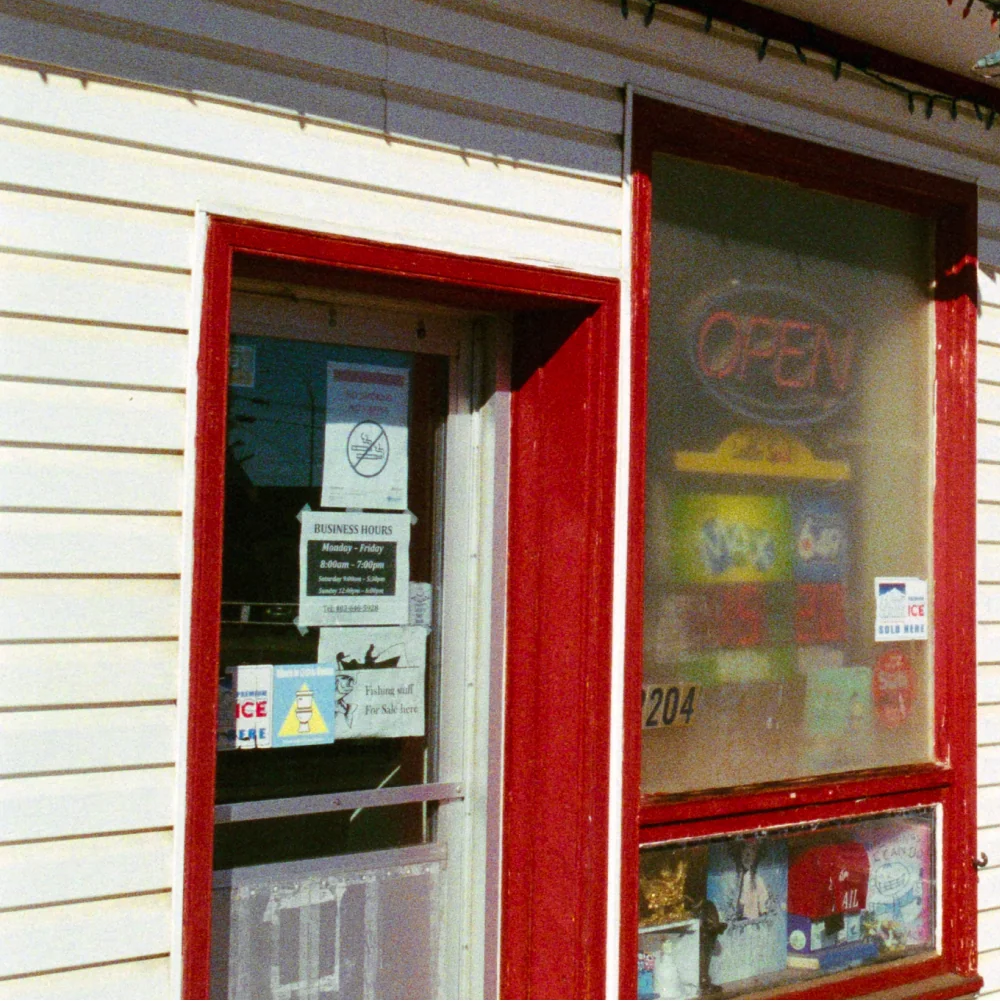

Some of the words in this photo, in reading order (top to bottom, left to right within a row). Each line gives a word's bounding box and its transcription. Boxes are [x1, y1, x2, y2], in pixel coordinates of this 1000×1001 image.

[697, 311, 853, 390] OPEN
[314, 523, 359, 534] BUSINESS
[361, 525, 393, 536] HOURS
[321, 543, 353, 554] Monday
[359, 544, 384, 555] Friday
[320, 560, 350, 569] 8:00am
[357, 560, 385, 571] 7:00pm
[908, 604, 924, 617] ICE
[365, 683, 396, 696] Fishing
[235, 700, 267, 718] ICE
[365, 704, 380, 715] For
[382, 703, 397, 714] Sale
[401, 703, 418, 713] here
